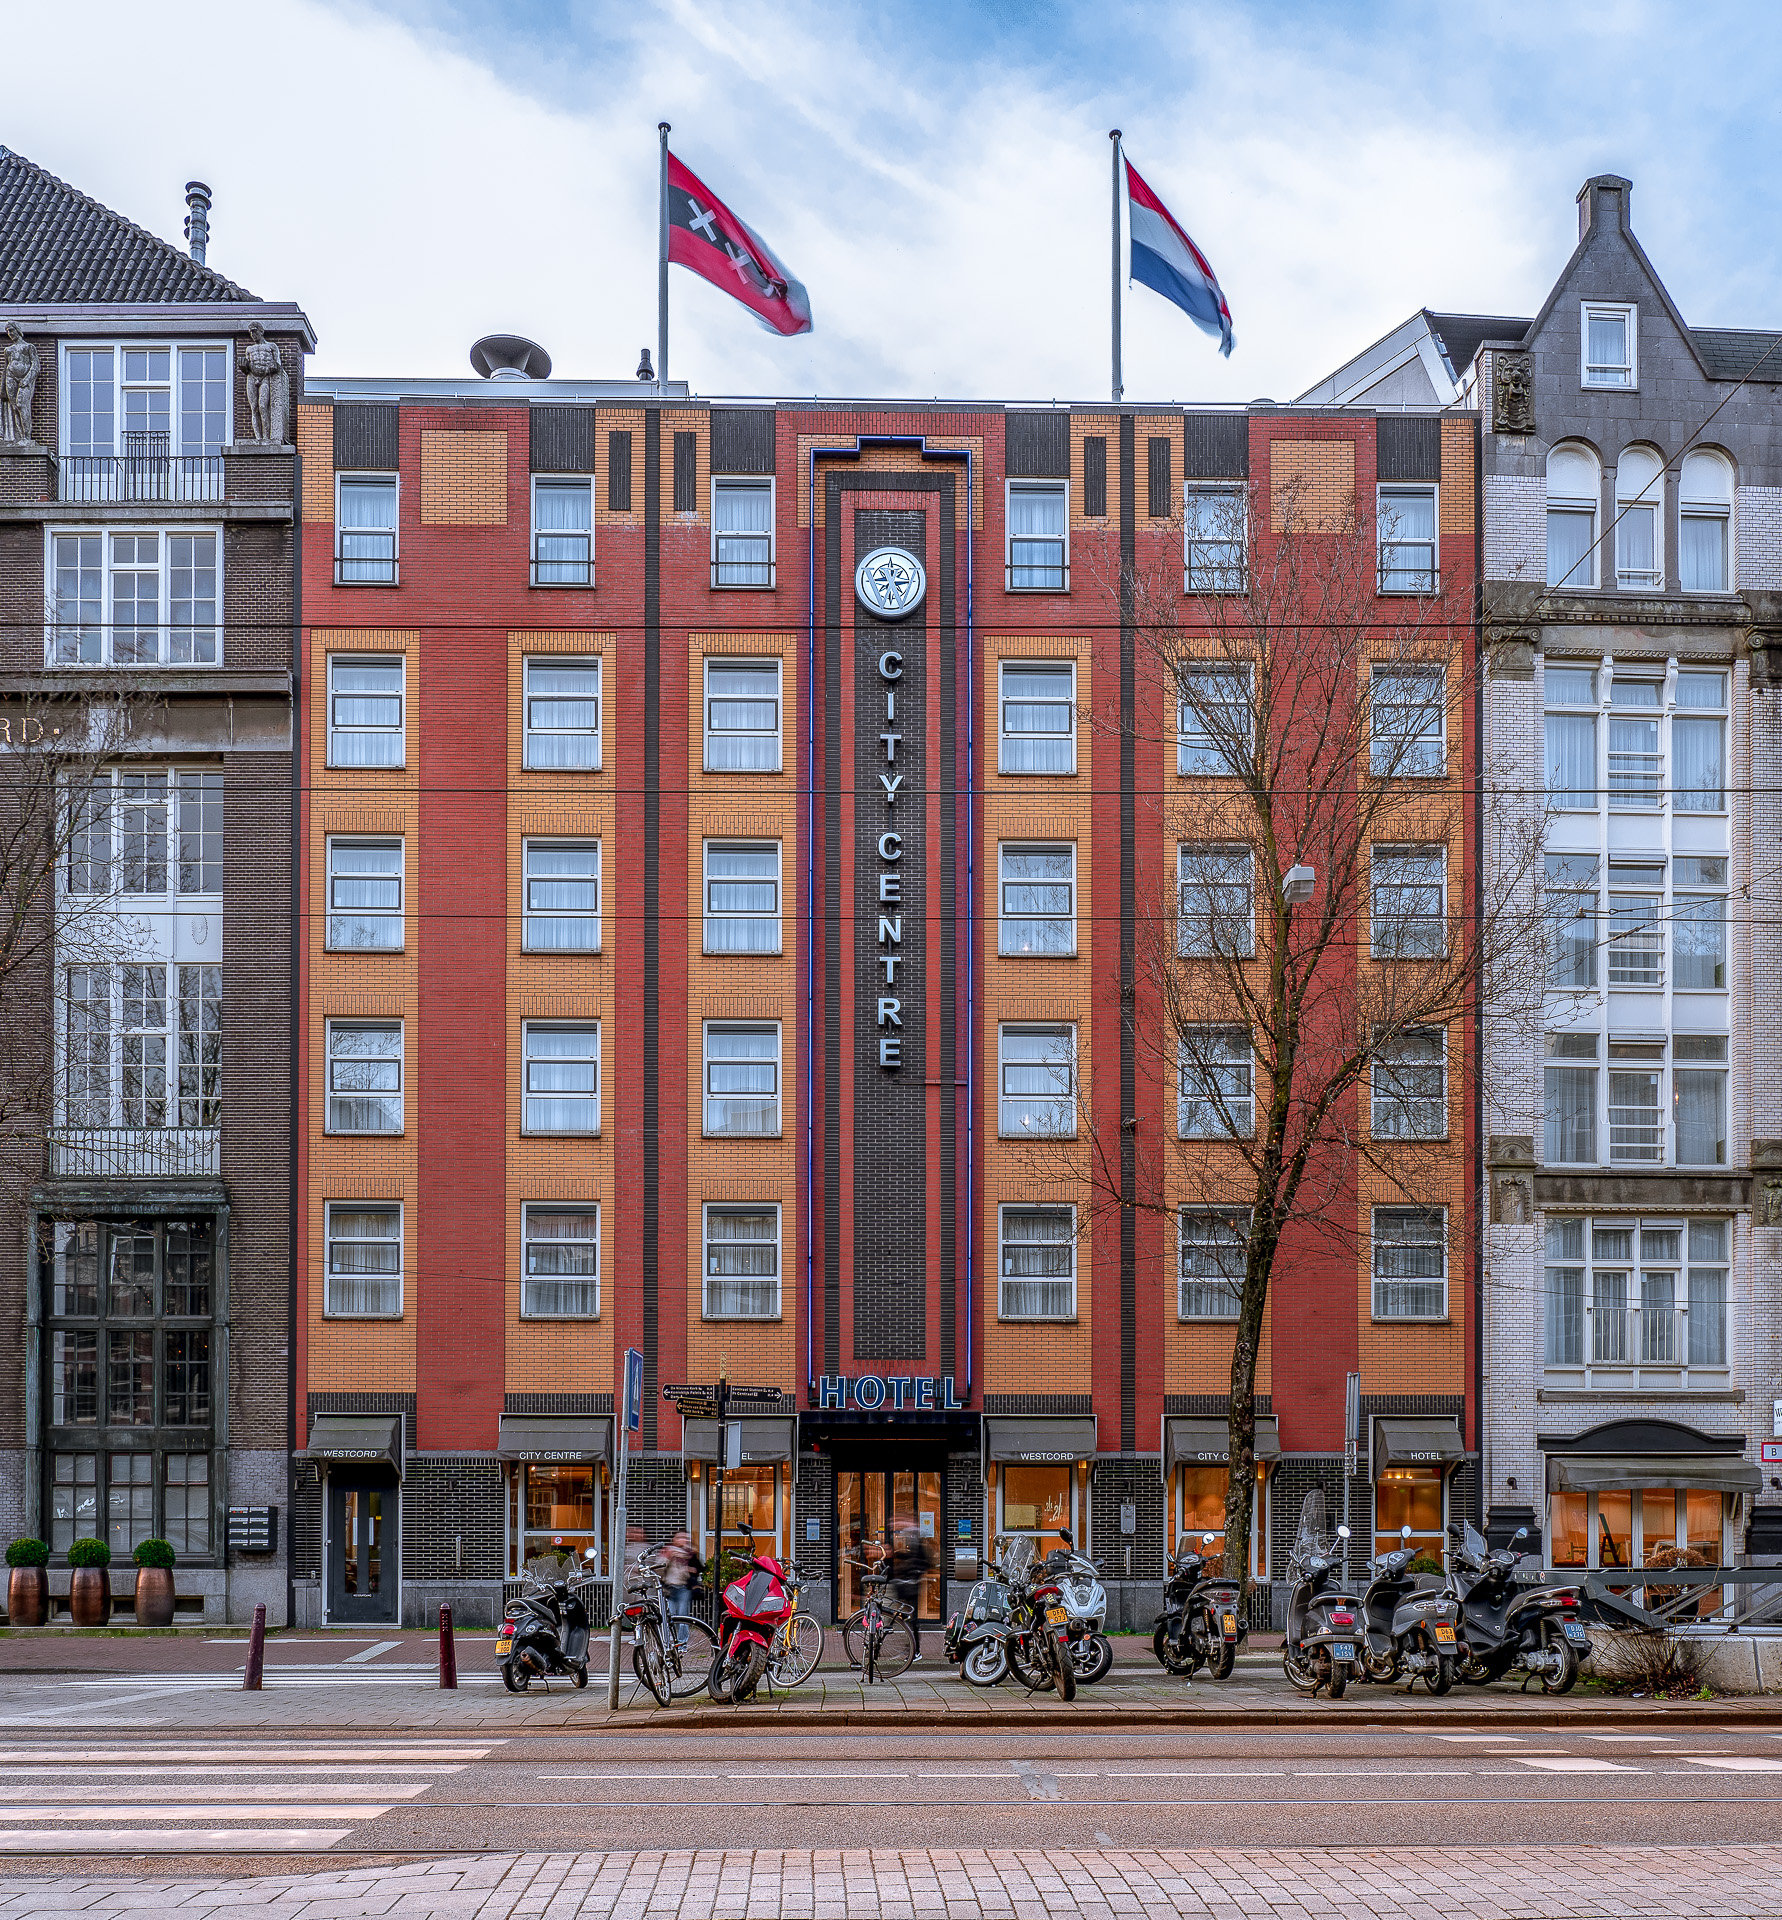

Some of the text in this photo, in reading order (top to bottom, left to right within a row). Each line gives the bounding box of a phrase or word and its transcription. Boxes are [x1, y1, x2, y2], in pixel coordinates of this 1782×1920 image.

[878, 651, 904, 1066] CITY CENTRE
[819, 1375, 962, 1409] HOTEL
[323, 1450, 377, 1458] WESTCORD
[519, 1451, 582, 1460] CITY CENTRE
[1020, 1452, 1074, 1461] WESTCORD
[1197, 1452, 1219, 1460] CITY
[1410, 1452, 1442, 1460] HOTEL
